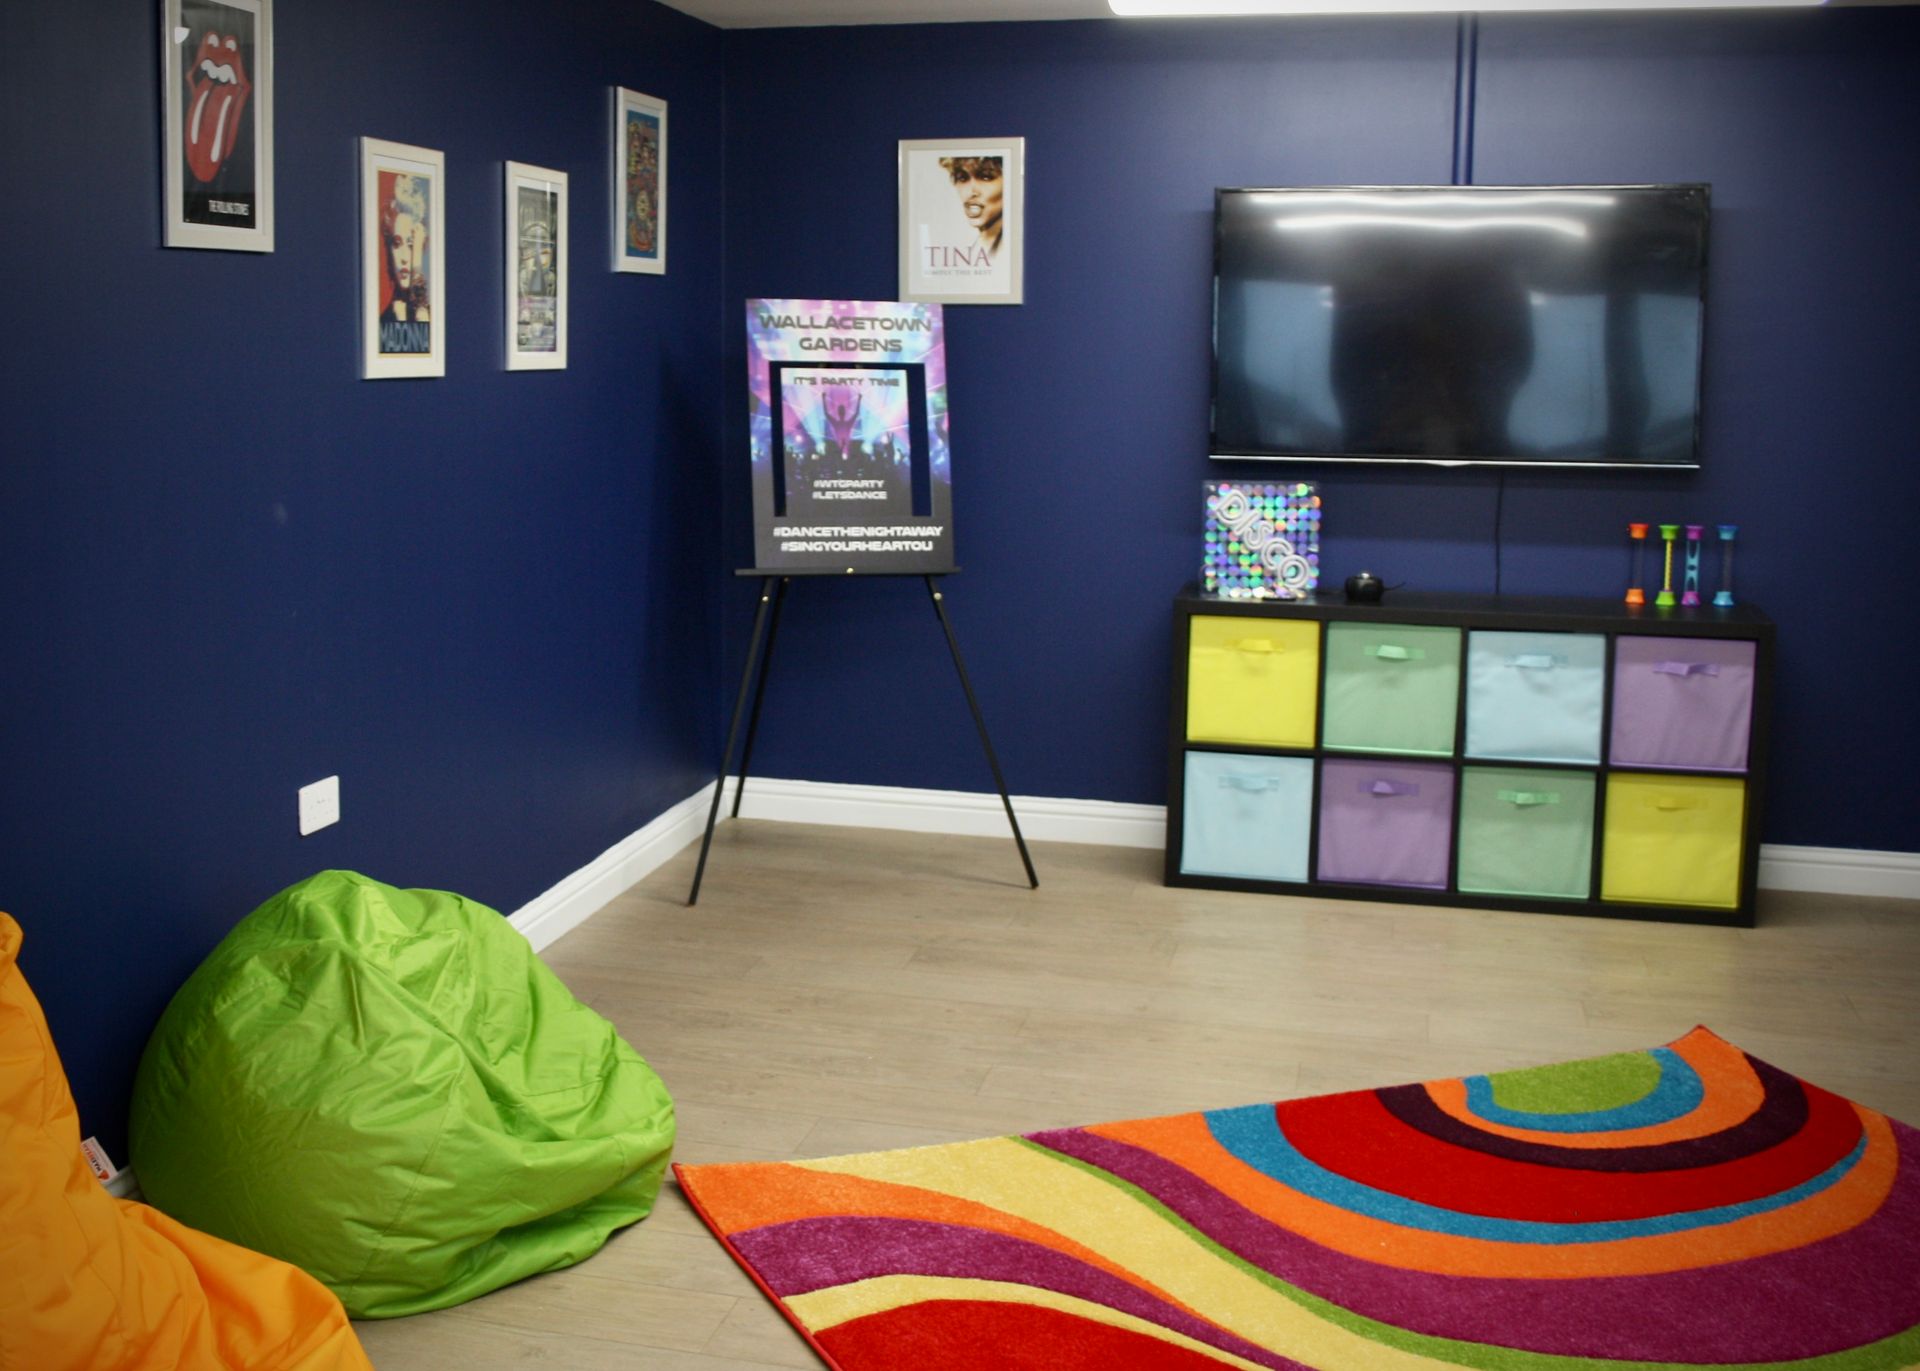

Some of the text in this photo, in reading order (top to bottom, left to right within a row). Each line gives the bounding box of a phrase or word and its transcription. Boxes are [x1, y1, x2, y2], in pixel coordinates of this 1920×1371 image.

[924, 245, 992, 267] TINA
[760, 314, 932, 332] WALLACETOWN
[799, 336, 903, 353] GARDENS
[793, 376, 900, 387] IT'S PARTY TIME
[813, 479, 885, 488] #WTGPARTY
[811, 490, 888, 500] #LETSDANCE
[772, 526, 944, 537] #DANCETHENIGHTAWAY
[1215, 488, 1309, 590] DISCO
[780, 540, 934, 551] #SINGYOURHEARTOU
